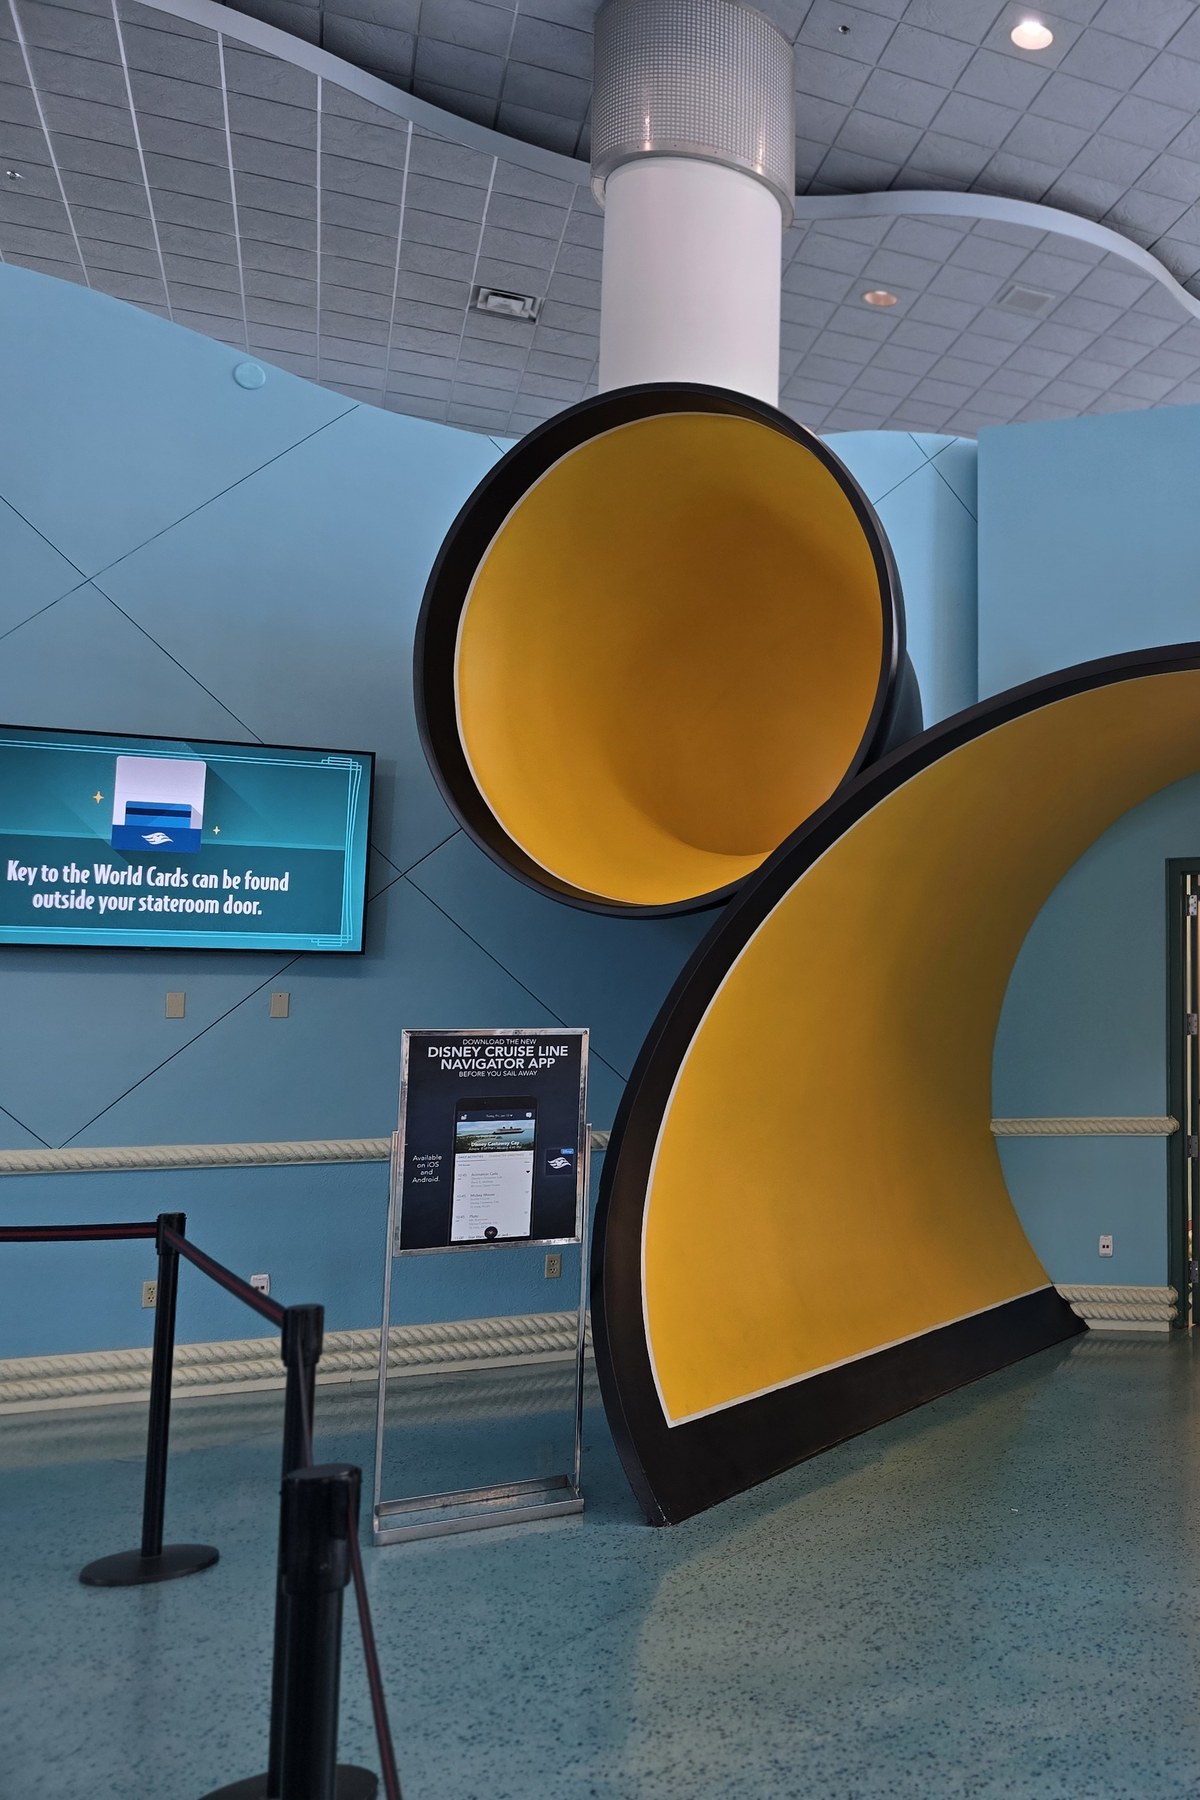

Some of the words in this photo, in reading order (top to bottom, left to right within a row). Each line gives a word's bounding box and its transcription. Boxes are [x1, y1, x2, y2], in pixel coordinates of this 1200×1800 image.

[7, 860, 37, 885] Key
[41, 865, 58, 882] to
[63, 863, 90, 883] the
[94, 864, 142, 885] World
[147, 866, 188, 887] Cards
[192, 874, 218, 888] can
[223, 869, 241, 889] be
[245, 871, 289, 891] found
[33, 889, 95, 909] outside
[99, 896, 136, 914] your
[138, 895, 219, 913] stateroom
[223, 895, 262, 914] door.
[428, 1047, 480, 1057] DISNEY
[485, 1046, 534, 1057] CRUISE
[539, 1046, 568, 1056] LINE
[441, 1058, 524, 1069] NAVIGATOR
[528, 1058, 556, 1069] APP
[412, 1154, 443, 1162] Available
[411, 1175, 440, 1184] Android.
